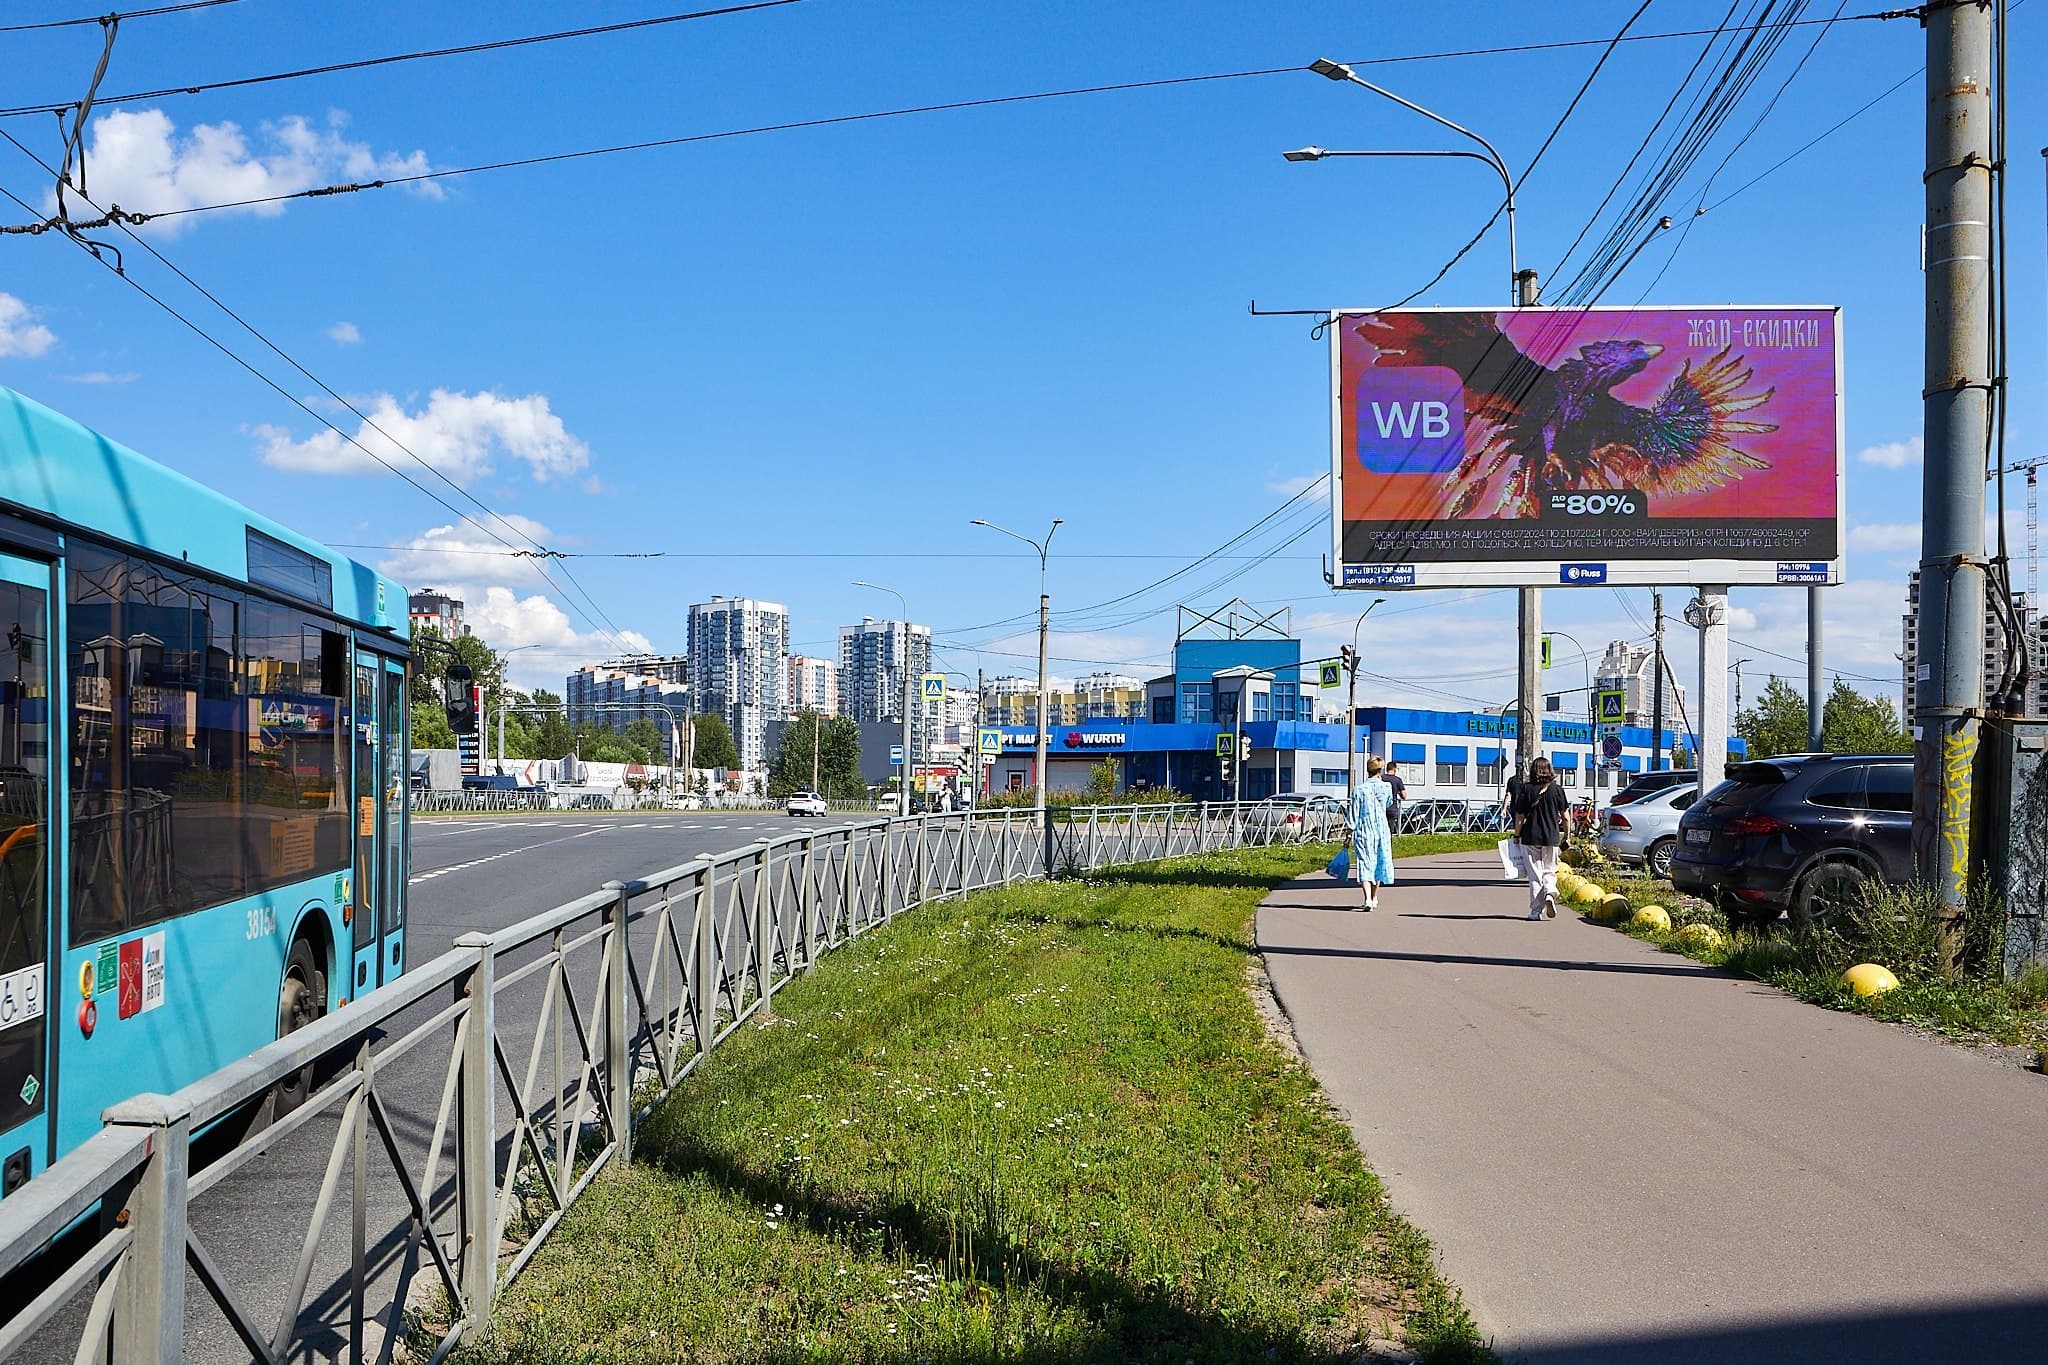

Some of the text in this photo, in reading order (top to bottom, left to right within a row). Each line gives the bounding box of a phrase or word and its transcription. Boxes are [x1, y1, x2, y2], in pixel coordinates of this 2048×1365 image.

[1371, 401, 1450, 439] WB
[1461, 530, 1492, 540] АКЦИИ
[1547, 529, 1560, 538] ПО
[1610, 528, 1630, 538] ООО
[1704, 528, 1728, 537] ОГРН
[1363, 566, 1381, 574] (812)
[1581, 569, 1601, 578] Russ
[246, 906, 276, 941] 38154
